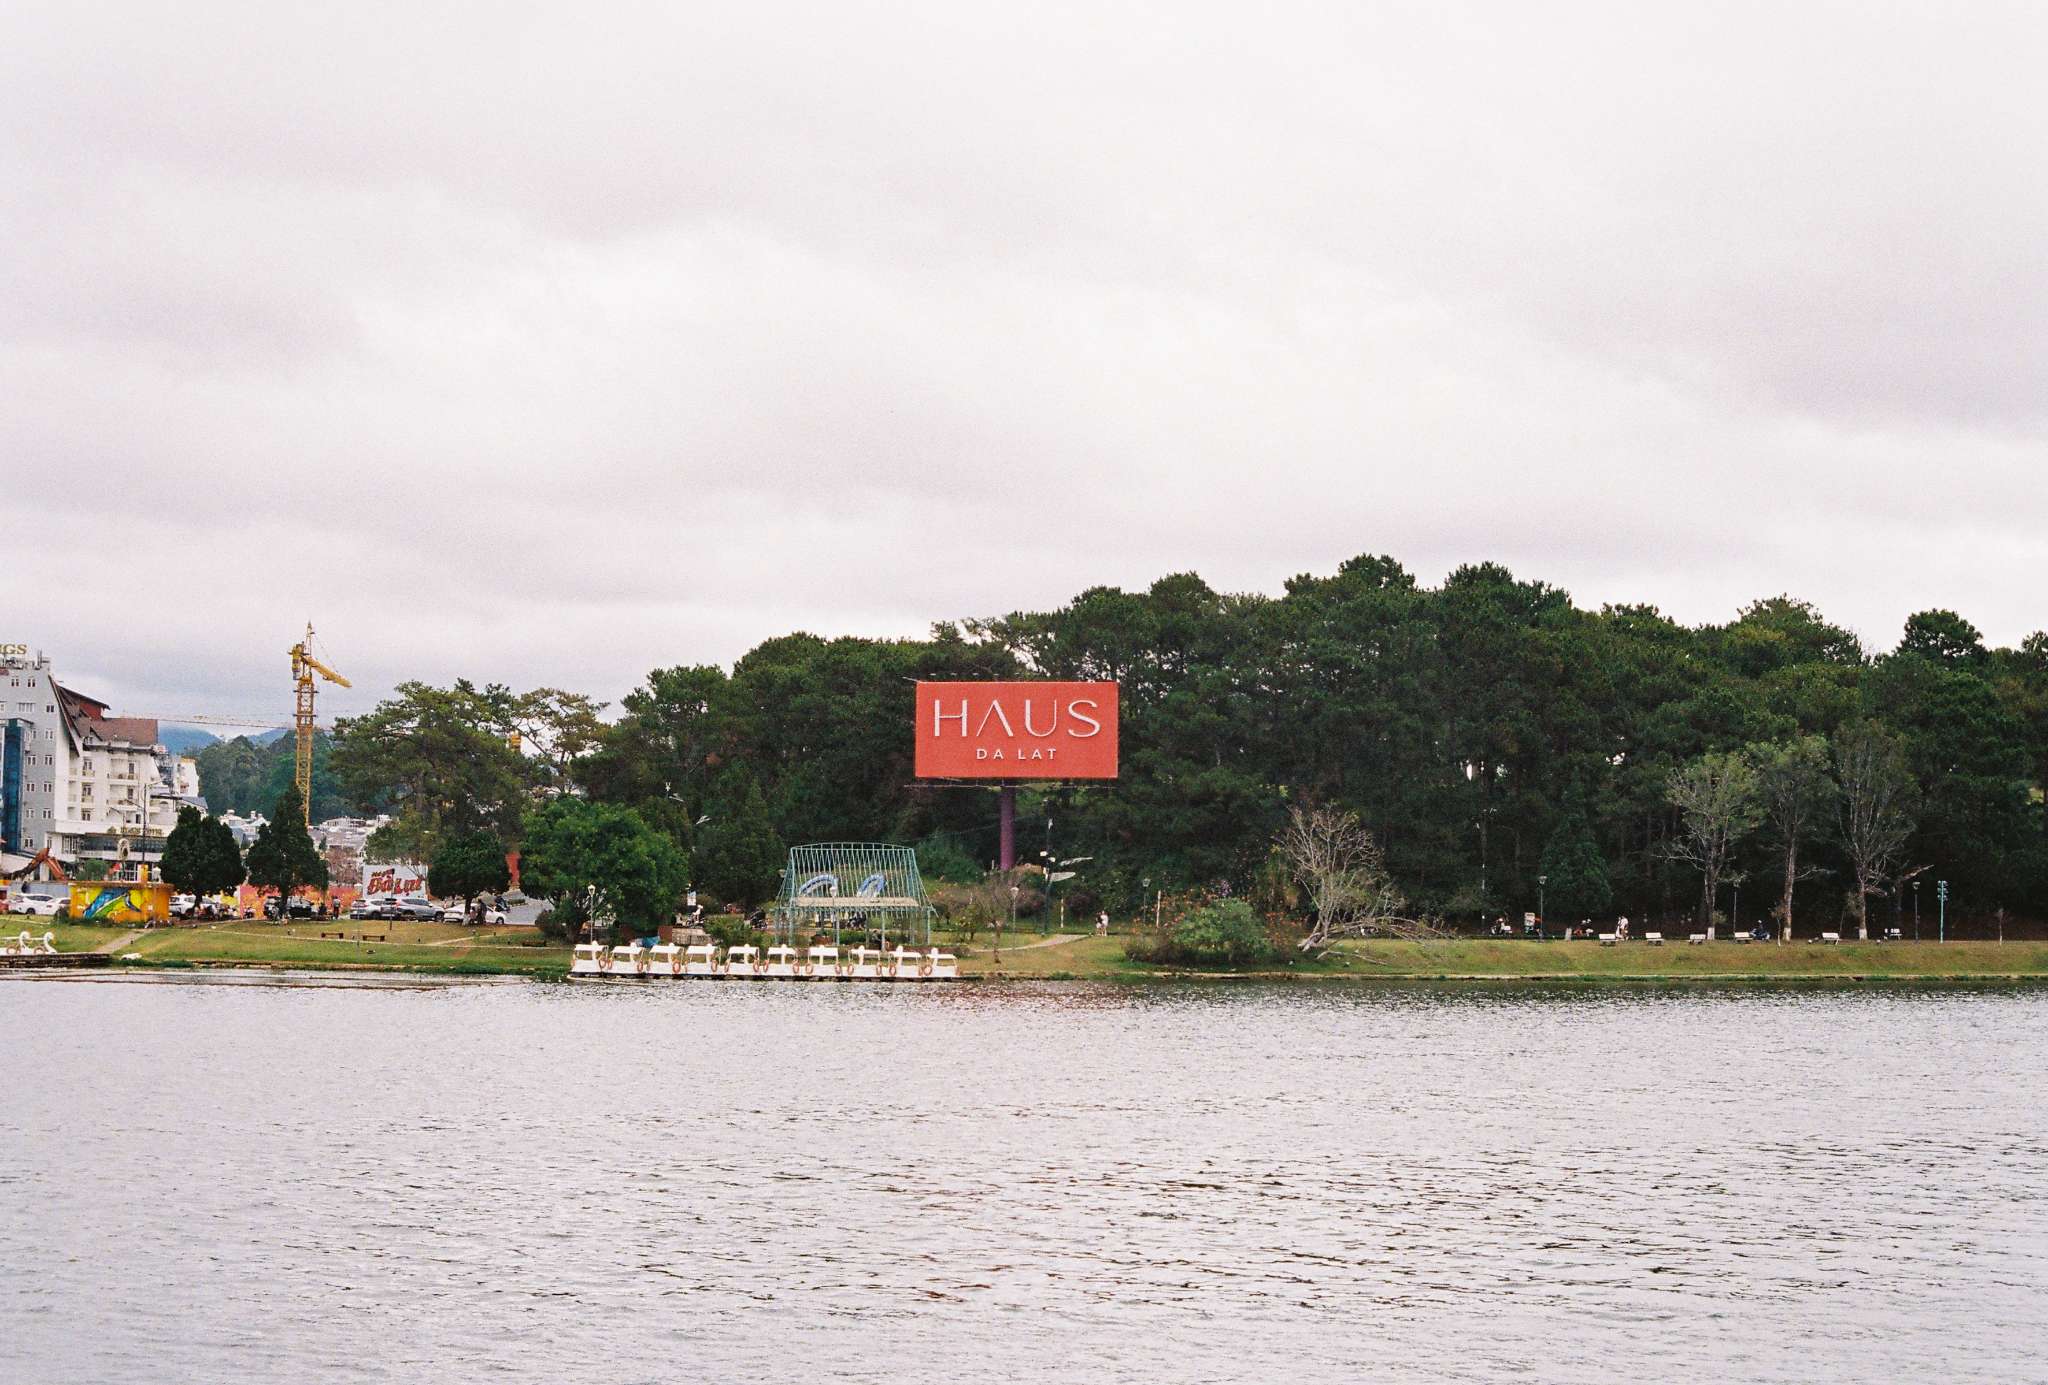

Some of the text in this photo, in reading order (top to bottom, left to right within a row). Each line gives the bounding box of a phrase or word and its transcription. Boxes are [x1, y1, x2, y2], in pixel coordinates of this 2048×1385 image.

[934, 699, 1101, 738] HAUS
[976, 748, 1057, 760] DA LAT
